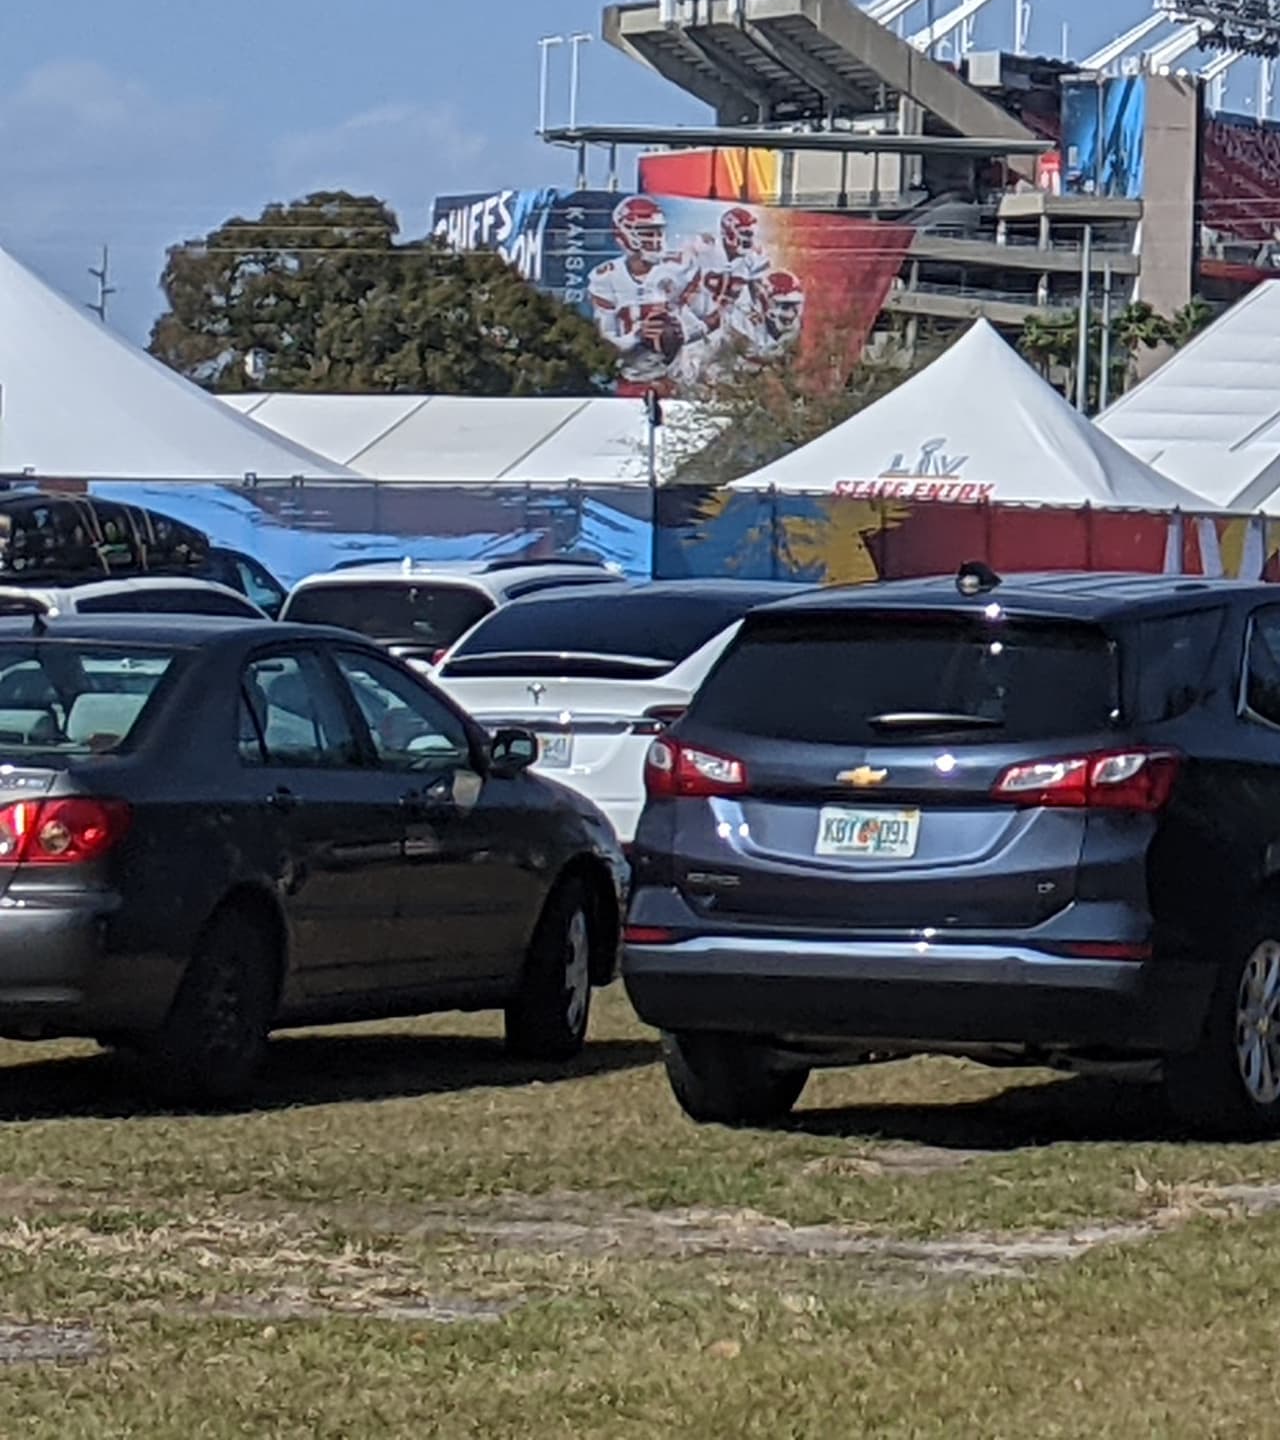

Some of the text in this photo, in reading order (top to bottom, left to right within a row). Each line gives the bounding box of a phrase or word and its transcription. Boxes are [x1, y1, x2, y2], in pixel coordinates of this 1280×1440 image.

[564, 206, 586, 303] KANSAS
[834, 479, 995, 503] STAFF ENTRY
